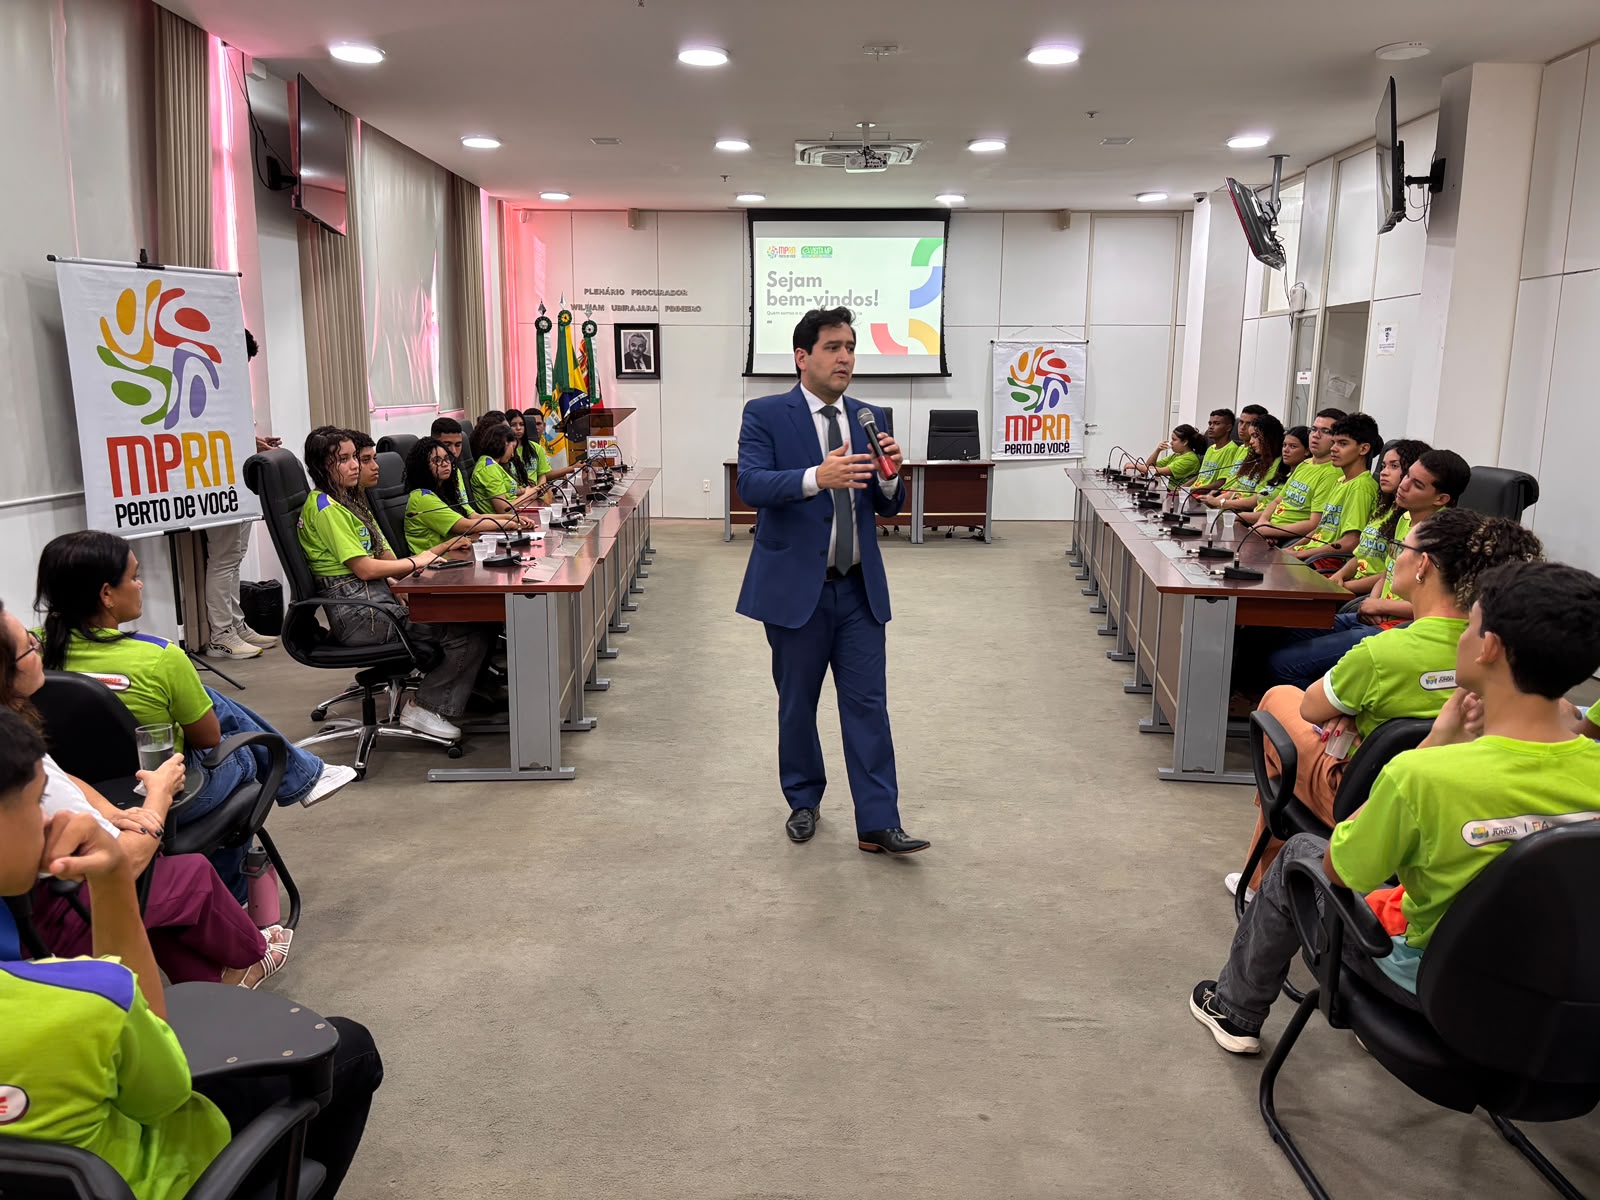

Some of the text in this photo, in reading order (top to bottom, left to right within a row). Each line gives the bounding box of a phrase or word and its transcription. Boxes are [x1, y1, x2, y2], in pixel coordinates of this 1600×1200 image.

[584, 287, 625, 296] PLENÁRIO
[767, 270, 822, 292] Sejam
[767, 289, 879, 306] bem-vindos!
[1005, 414, 1070, 442] MPRN
[1005, 440, 1070, 455] PERTO DE VOCÊ
[106, 430, 236, 498] MPRN
[115, 486, 239, 528] PERTO DE VOCÊ
